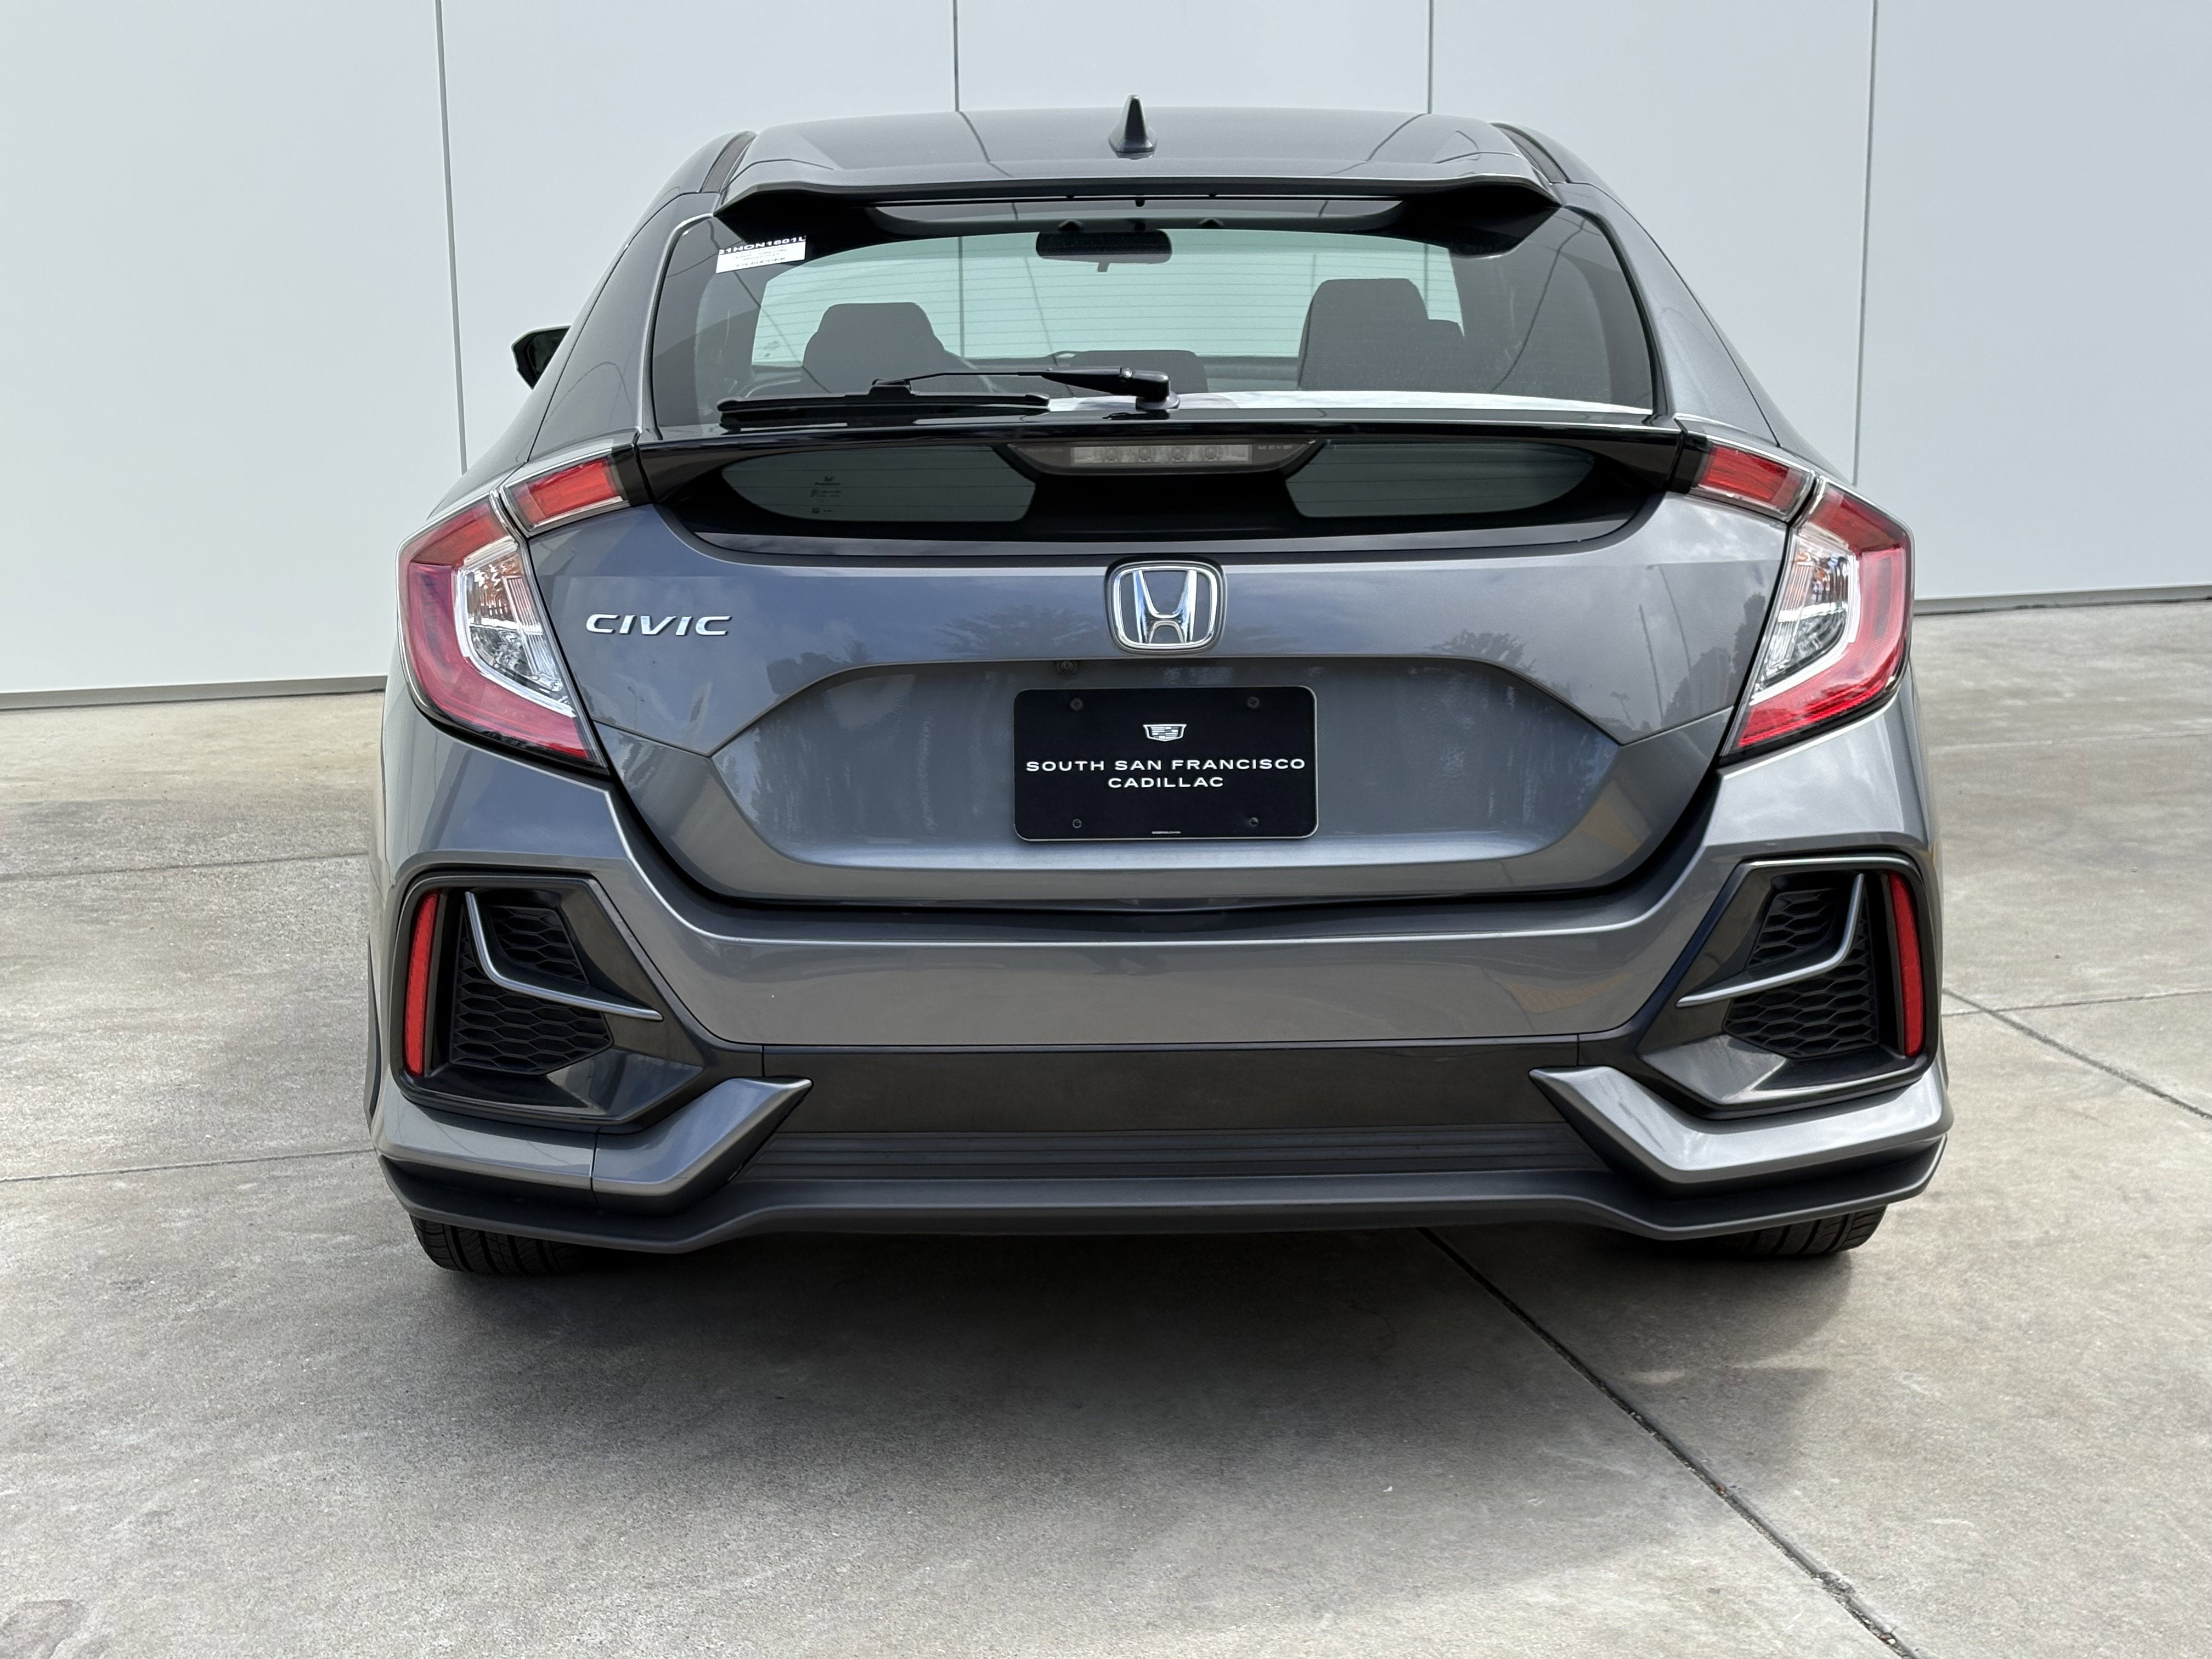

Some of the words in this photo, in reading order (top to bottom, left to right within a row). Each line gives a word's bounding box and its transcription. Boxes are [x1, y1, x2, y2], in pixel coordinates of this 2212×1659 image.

[586, 614, 731, 636] CIVIC
[1026, 760, 1104, 772] SOUTH
[1115, 760, 1161, 771] SAN
[1172, 759, 1305, 770] FRANCISCO
[1108, 777, 1223, 788] CADILLAC
